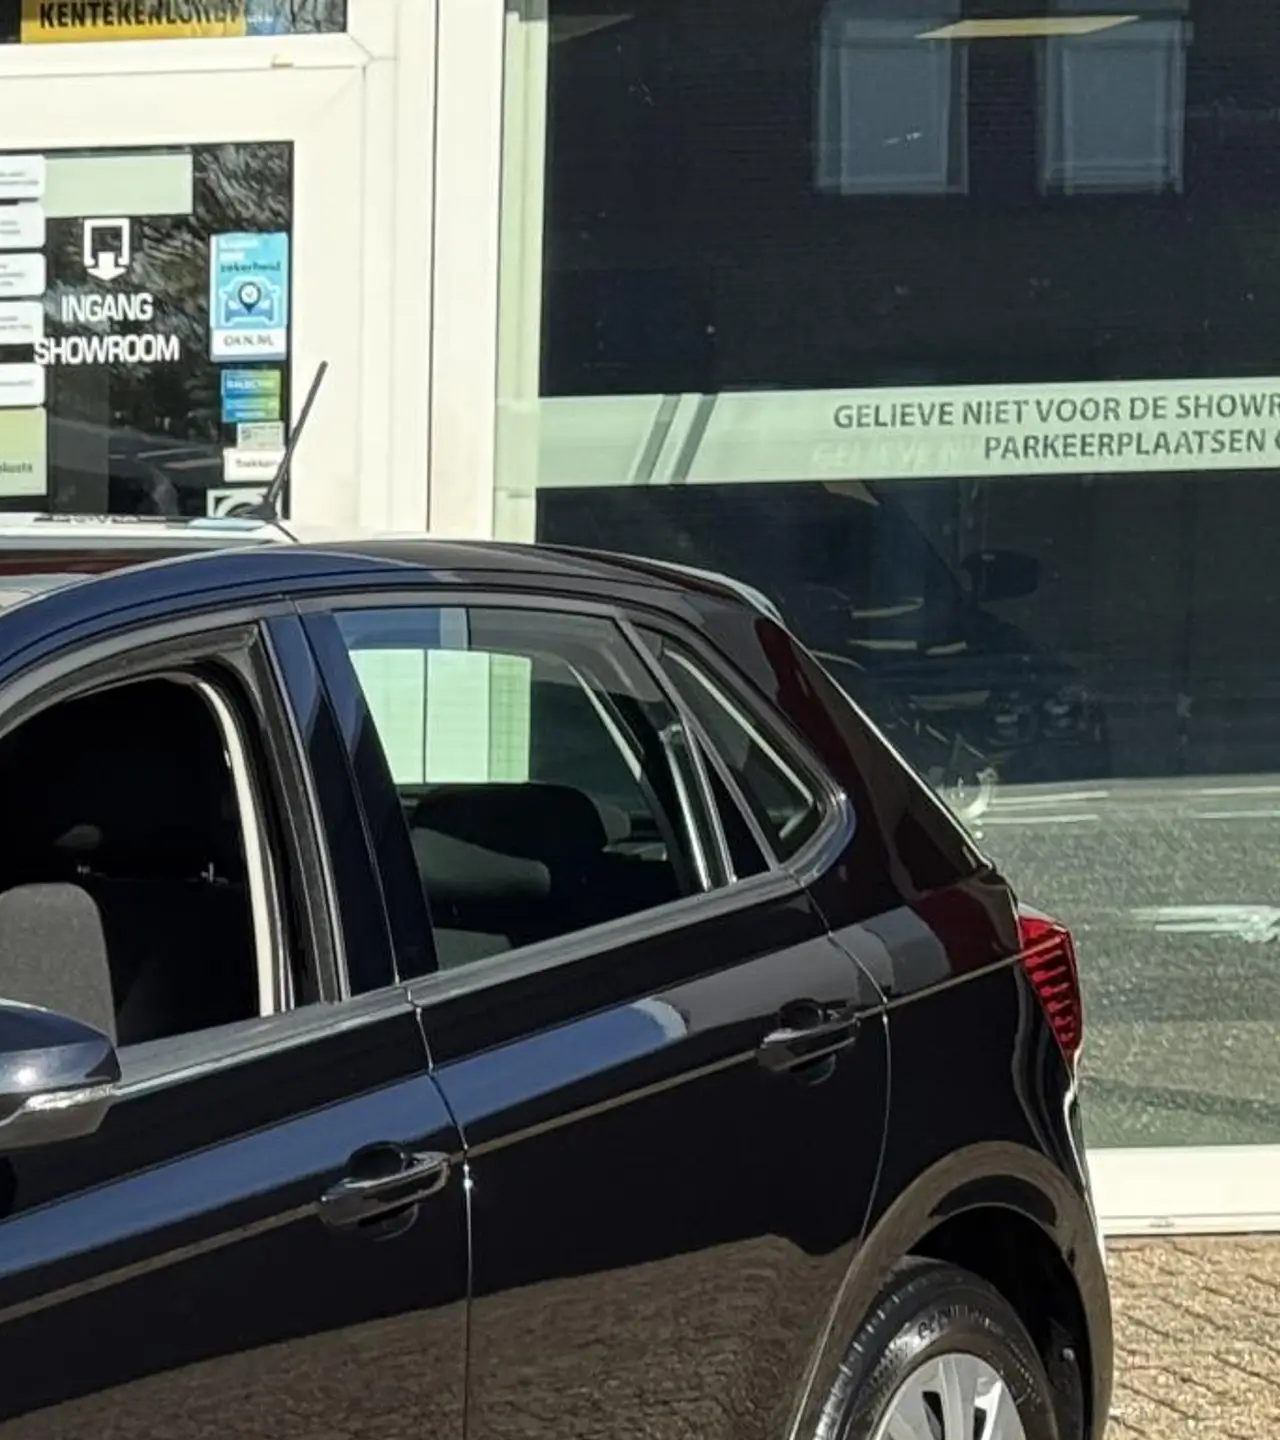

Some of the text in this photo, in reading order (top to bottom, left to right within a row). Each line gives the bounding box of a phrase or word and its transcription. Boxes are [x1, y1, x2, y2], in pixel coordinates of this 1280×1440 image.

[61, 291, 154, 324] INGANG
[33, 333, 180, 366] SHOWROOM
[833, 402, 954, 429] GELIEVE
[962, 399, 1029, 426] NIET
[1035, 396, 1122, 423] VOOR
[1129, 396, 1168, 421] DE
[984, 429, 1266, 460] PARKEERPLAATSEN
